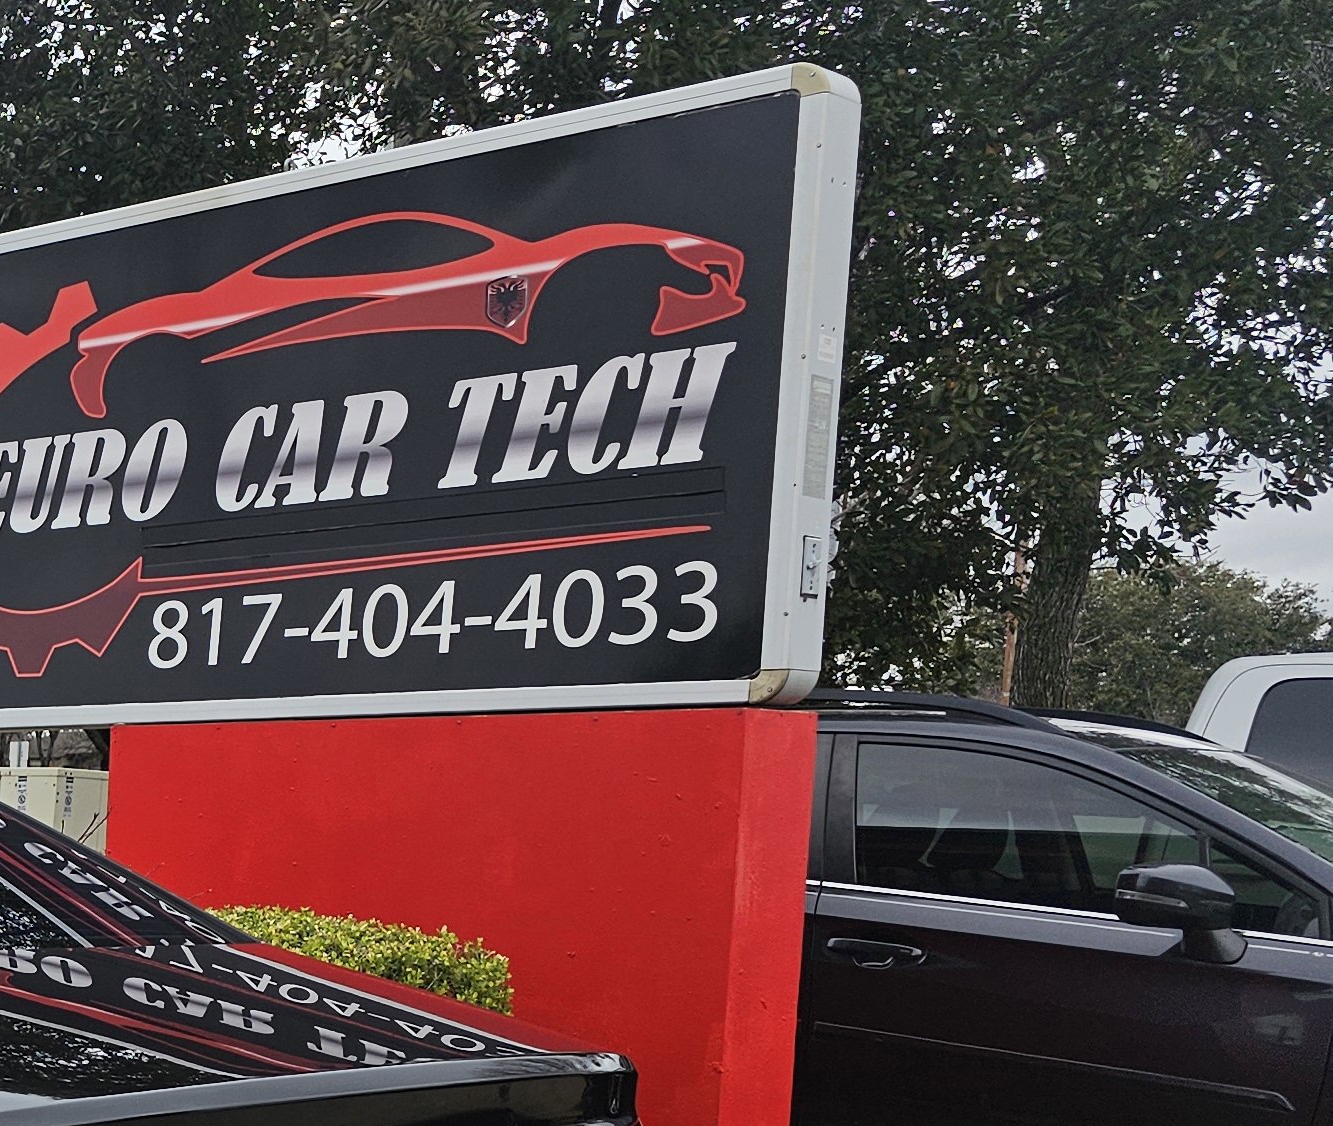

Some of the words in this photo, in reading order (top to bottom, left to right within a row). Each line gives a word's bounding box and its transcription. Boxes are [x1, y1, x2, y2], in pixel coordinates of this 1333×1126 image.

[215, 390, 409, 512] CAR
[436, 341, 737, 489] TECH
[147, 560, 719, 669] 817-404-4033
